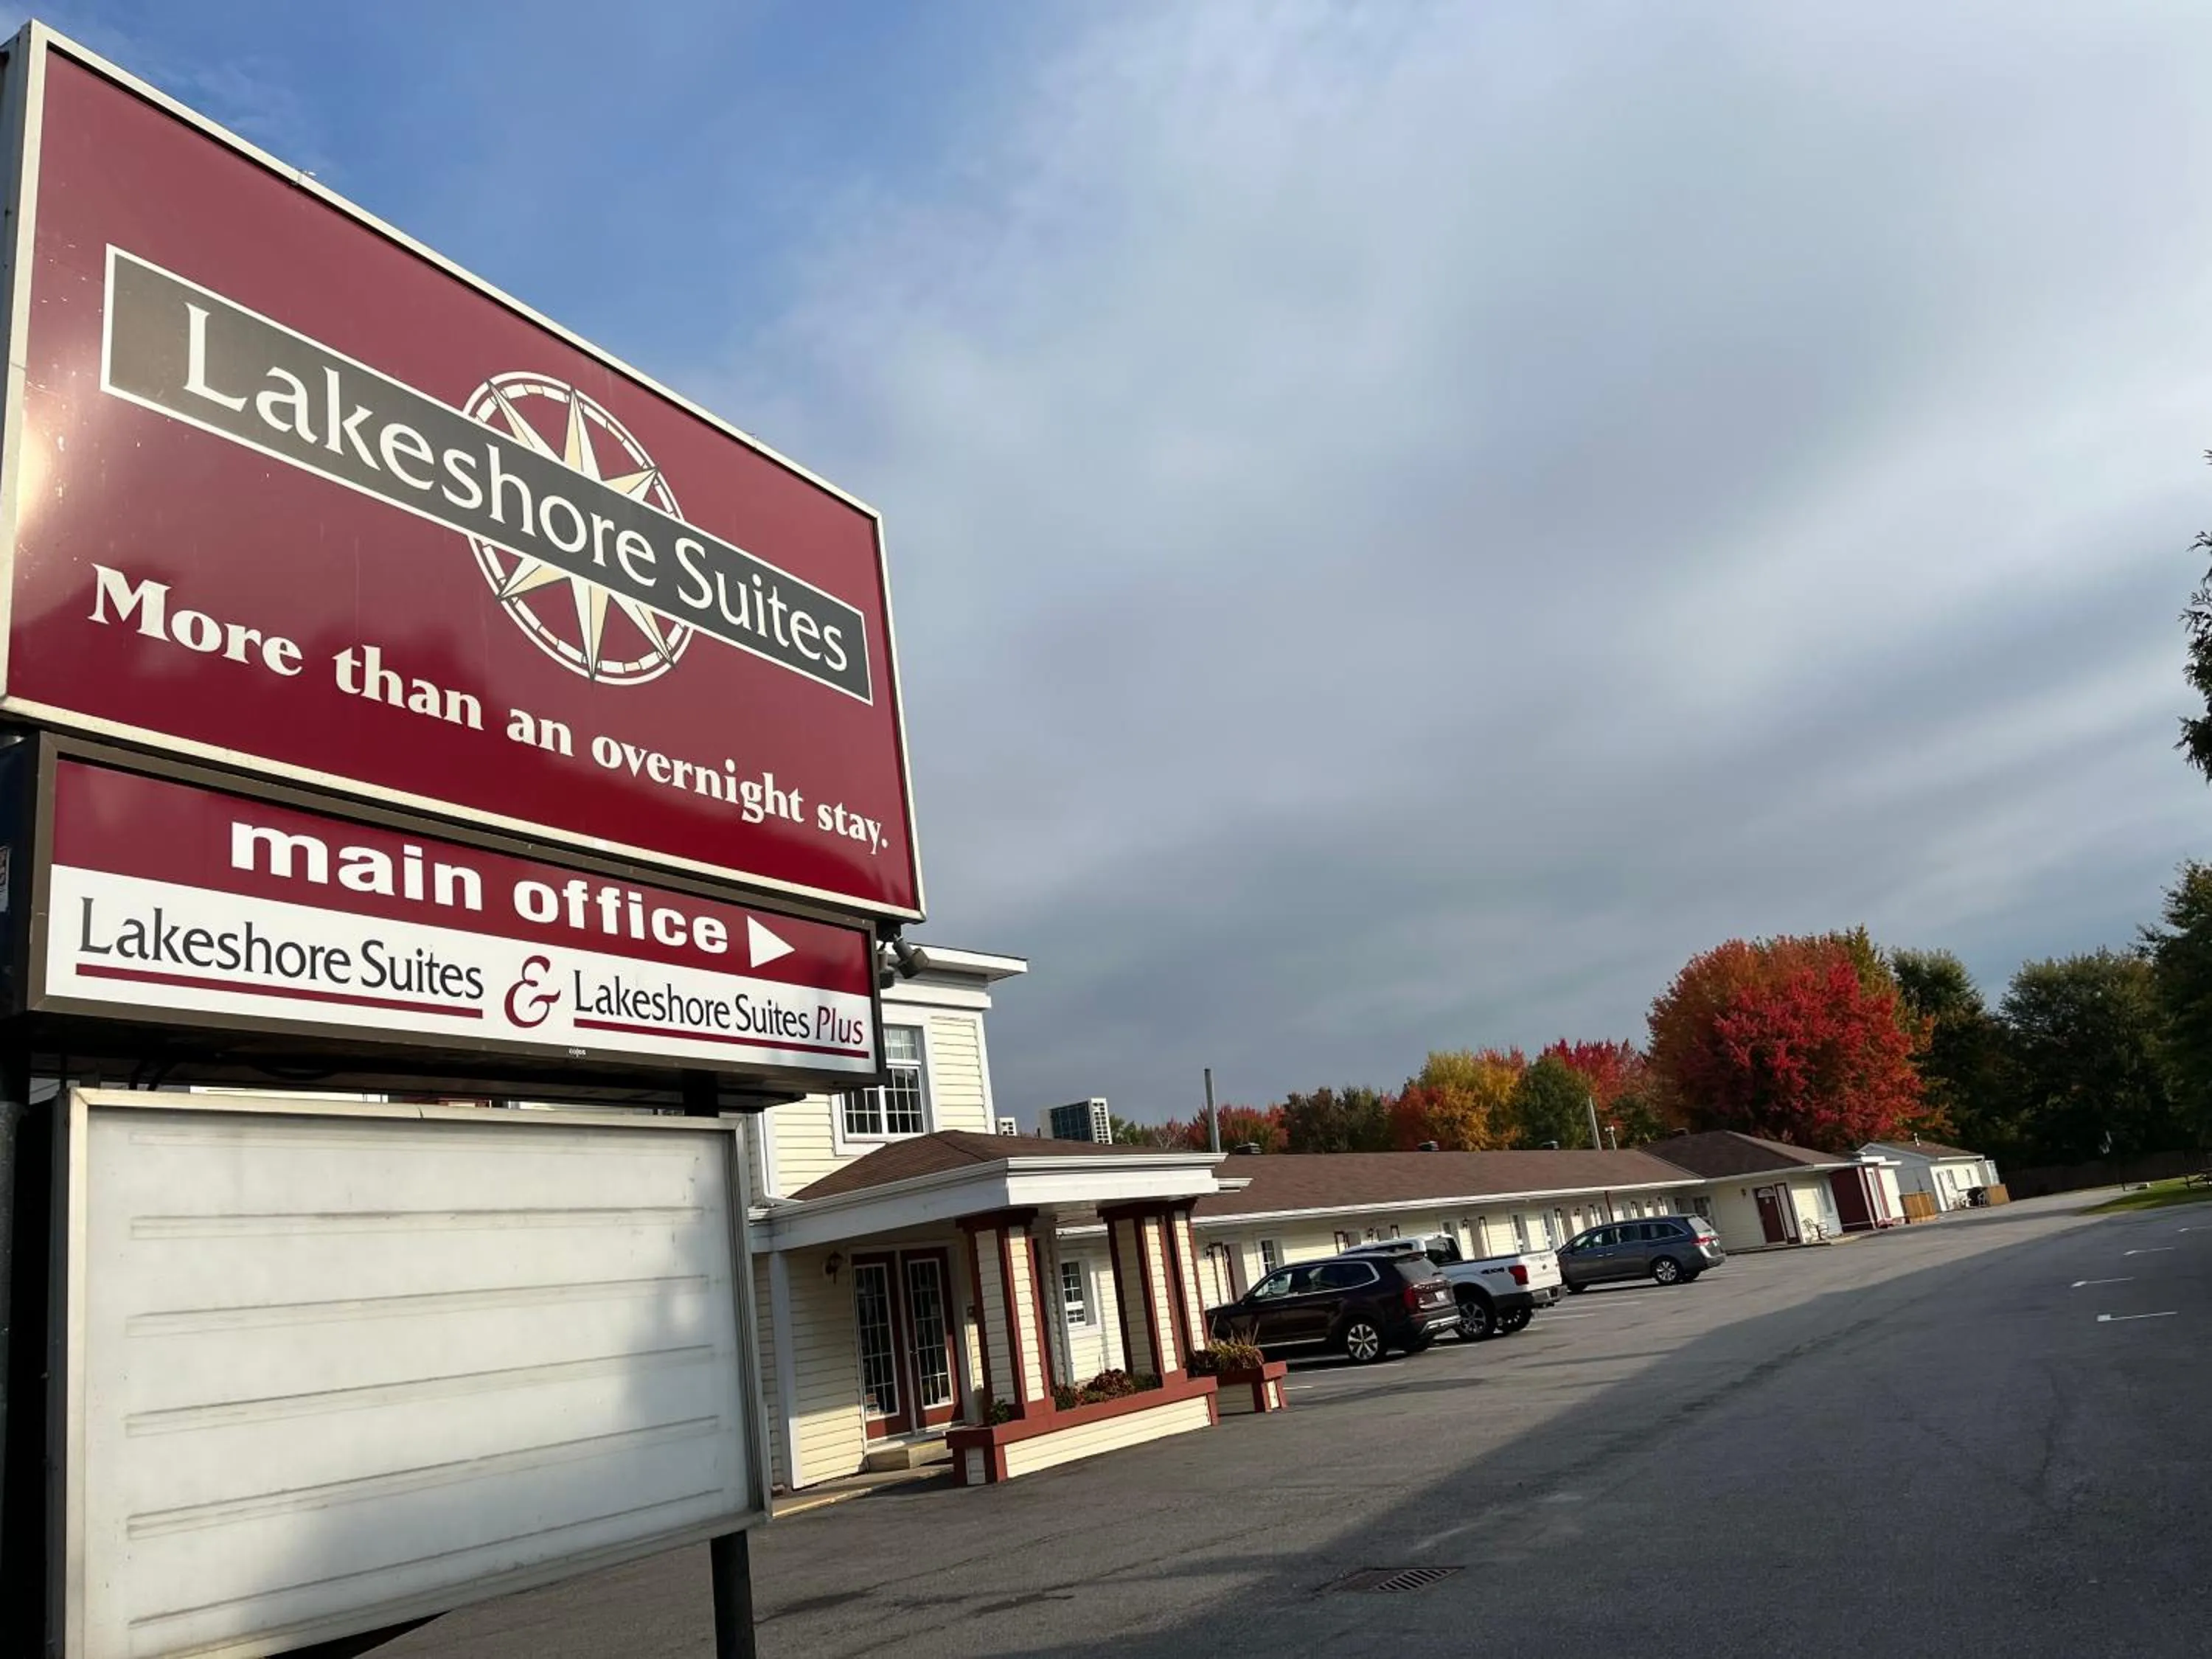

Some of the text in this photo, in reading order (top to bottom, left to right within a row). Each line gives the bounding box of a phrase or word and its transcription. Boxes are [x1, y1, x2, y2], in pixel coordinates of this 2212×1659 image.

[184, 302, 847, 672] Lakeshore Suites
[88, 563, 888, 855] More than an overnight stay.
[80, 897, 863, 1045] Lakeshore Suites & Lakeshore Suites Plus
[232, 821, 728, 954] main office
